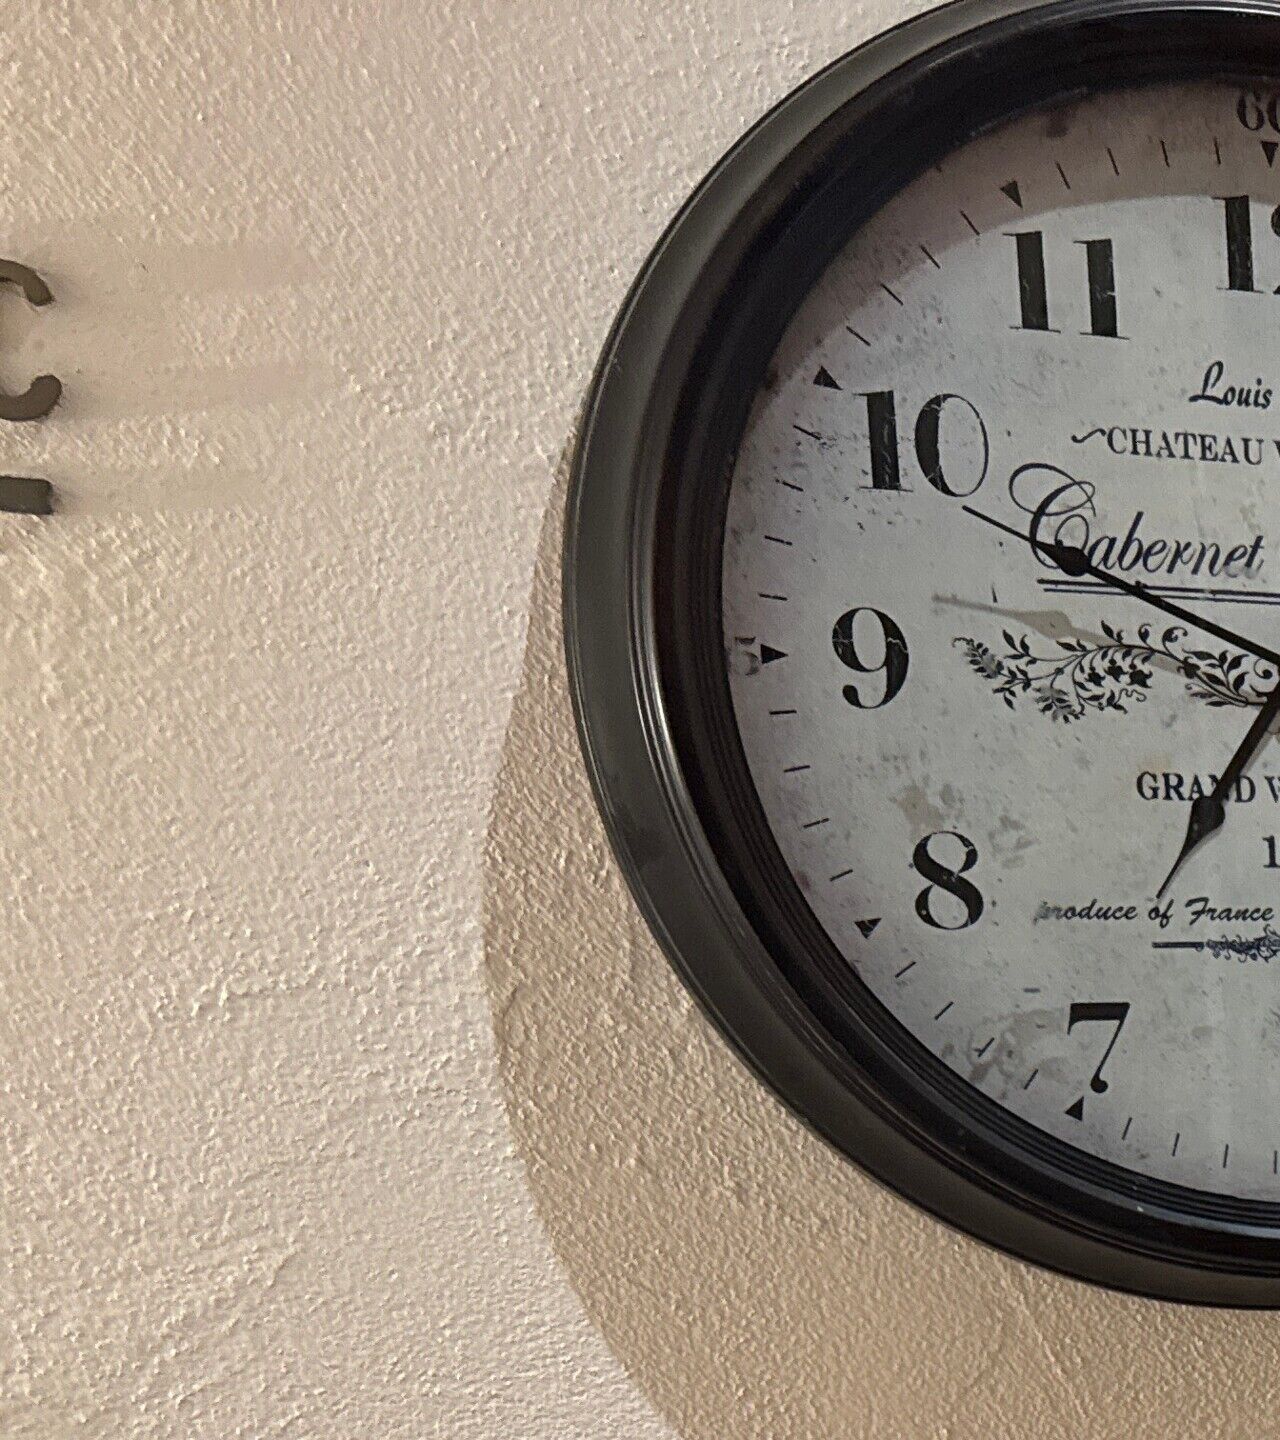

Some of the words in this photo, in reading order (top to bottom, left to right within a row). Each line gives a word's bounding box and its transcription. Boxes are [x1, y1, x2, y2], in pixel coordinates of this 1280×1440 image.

[1003, 229, 1132, 340] 11
[1188, 360, 1273, 411] Louis
[851, 389, 990, 499] 10
[1105, 426, 1265, 467] CHATEAU
[1009, 461, 1266, 578] Cabernet
[832, 606, 909, 710] 9
[912, 830, 985, 931] 8
[1148, 897, 1174, 932] of
[1183, 898, 1275, 924] France
[1067, 1000, 1131, 1094] 7
